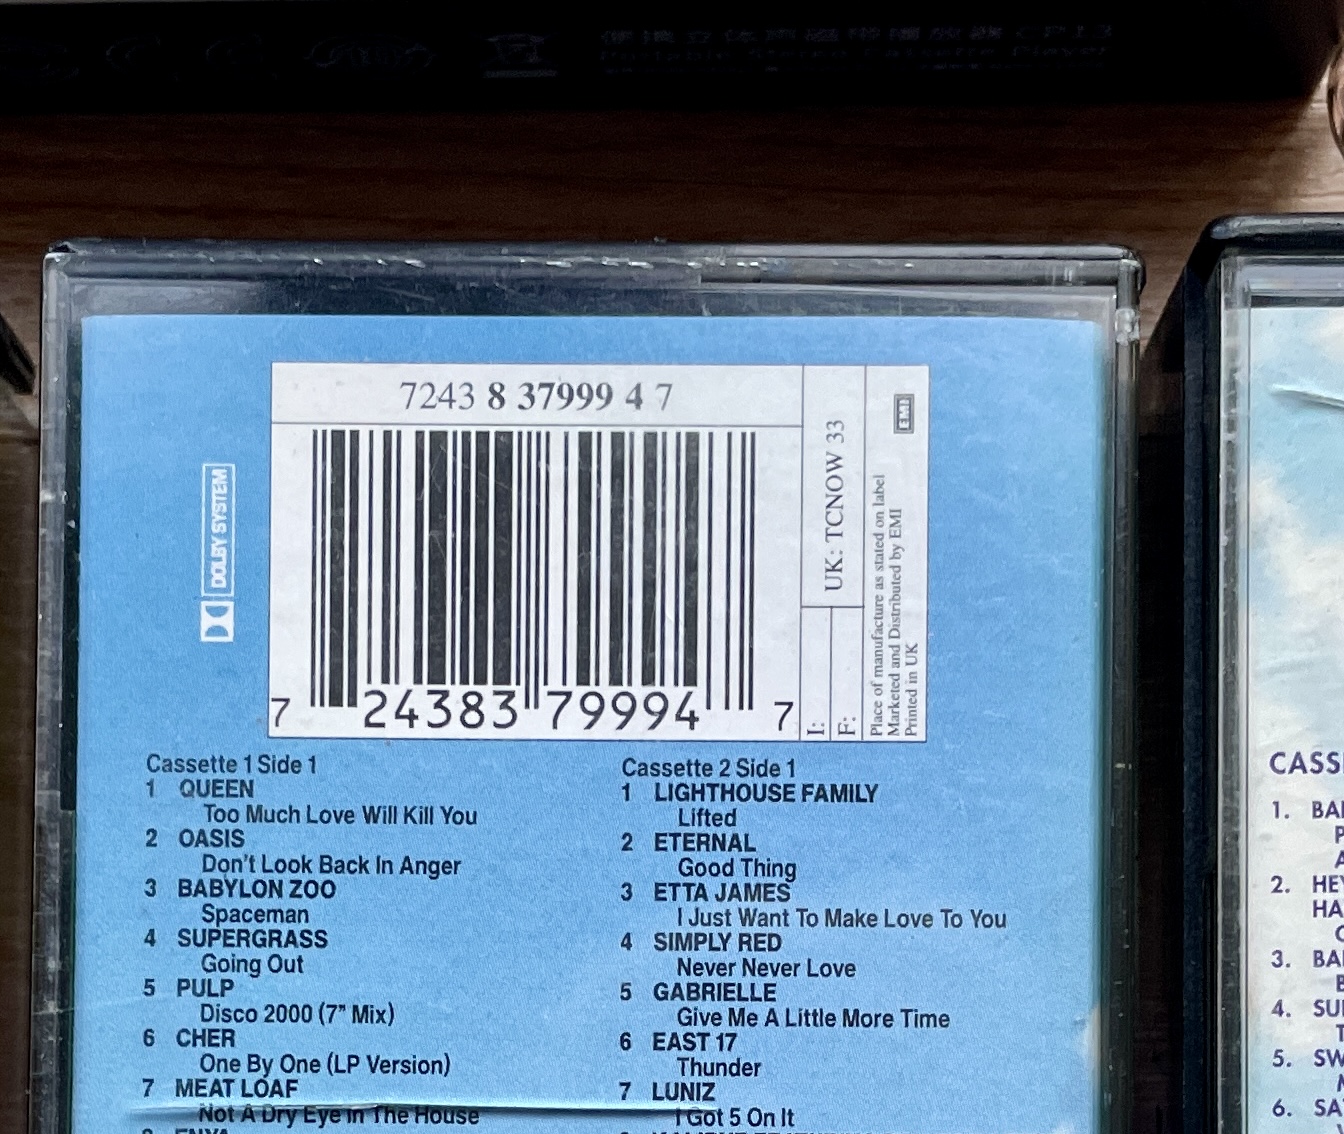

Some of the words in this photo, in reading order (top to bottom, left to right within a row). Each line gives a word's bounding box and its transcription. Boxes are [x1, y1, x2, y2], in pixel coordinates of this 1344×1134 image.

[400, 382, 474, 410] 7243
[488, 382, 505, 409] 8
[518, 383, 613, 410] 37999
[626, 383, 643, 410] 4
[656, 384, 672, 410] 7
[897, 395, 912, 432] EMI
[826, 420, 844, 443] 33
[211, 469, 228, 533] SYSTEM
[825, 452, 843, 543] TCNOW
[211, 536, 227, 588] DOLBY
[825, 551, 842, 591] UK:
[905, 644, 918, 666] UK
[272, 698, 290, 726] 7
[365, 689, 517, 729] 24383
[547, 691, 699, 730] 79994
[775, 702, 793, 731] 7
[905, 689, 917, 735] Printed
[147, 754, 237, 773] Cassette
[243, 753, 252, 774] 1
[258, 754, 302, 774] Side
[307, 755, 316, 775] 1
[622, 758, 713, 777] Cassette
[720, 759, 730, 777] 2
[737, 758, 780, 778] Side
[786, 757, 795, 778] 1
[145, 878, 156, 897] 3
[178, 878, 283, 898] BABYLON
[289, 880, 336, 899] ZOO
[202, 903, 309, 927] Spaceman
[1273, 1099, 1291, 1117] 6.
